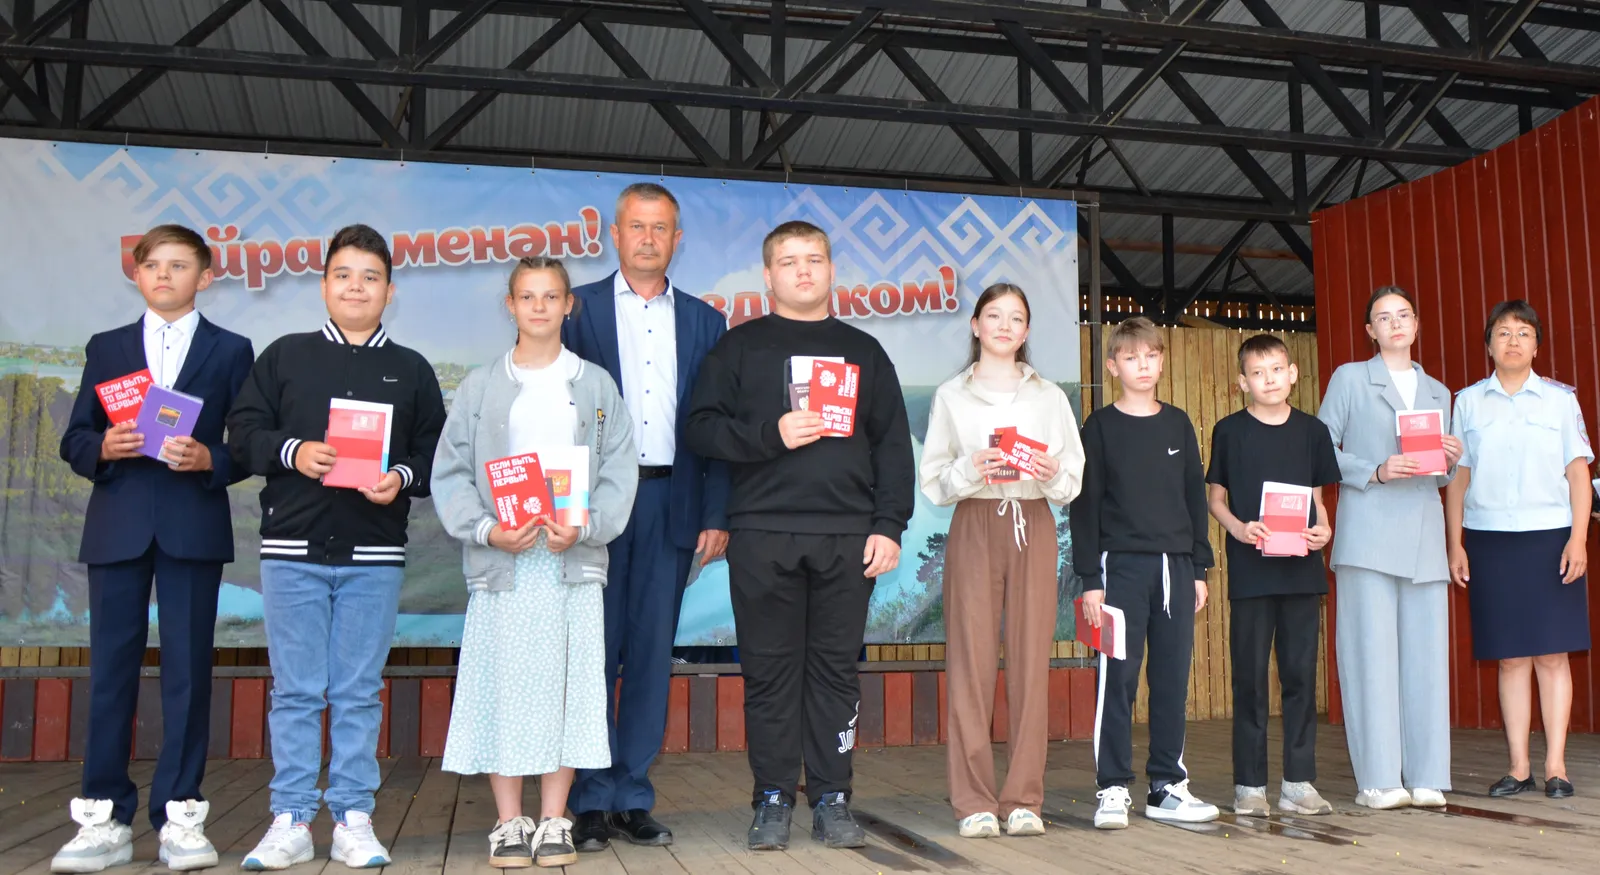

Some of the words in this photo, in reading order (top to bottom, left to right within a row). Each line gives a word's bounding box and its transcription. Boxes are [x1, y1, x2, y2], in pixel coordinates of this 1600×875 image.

[390, 207, 602, 268] менән!
[100, 382, 122, 396] ЕСЛИ
[103, 395, 115, 404] ТО
[115, 388, 140, 400] БЫТЬ
[107, 395, 144, 412] ПЕРВЫМ
[489, 460, 511, 472] ЕСЛИ
[491, 471, 503, 479] ТО
[503, 466, 526, 475] БЫТЬ
[493, 474, 528, 488] ПЕРВЫМ
